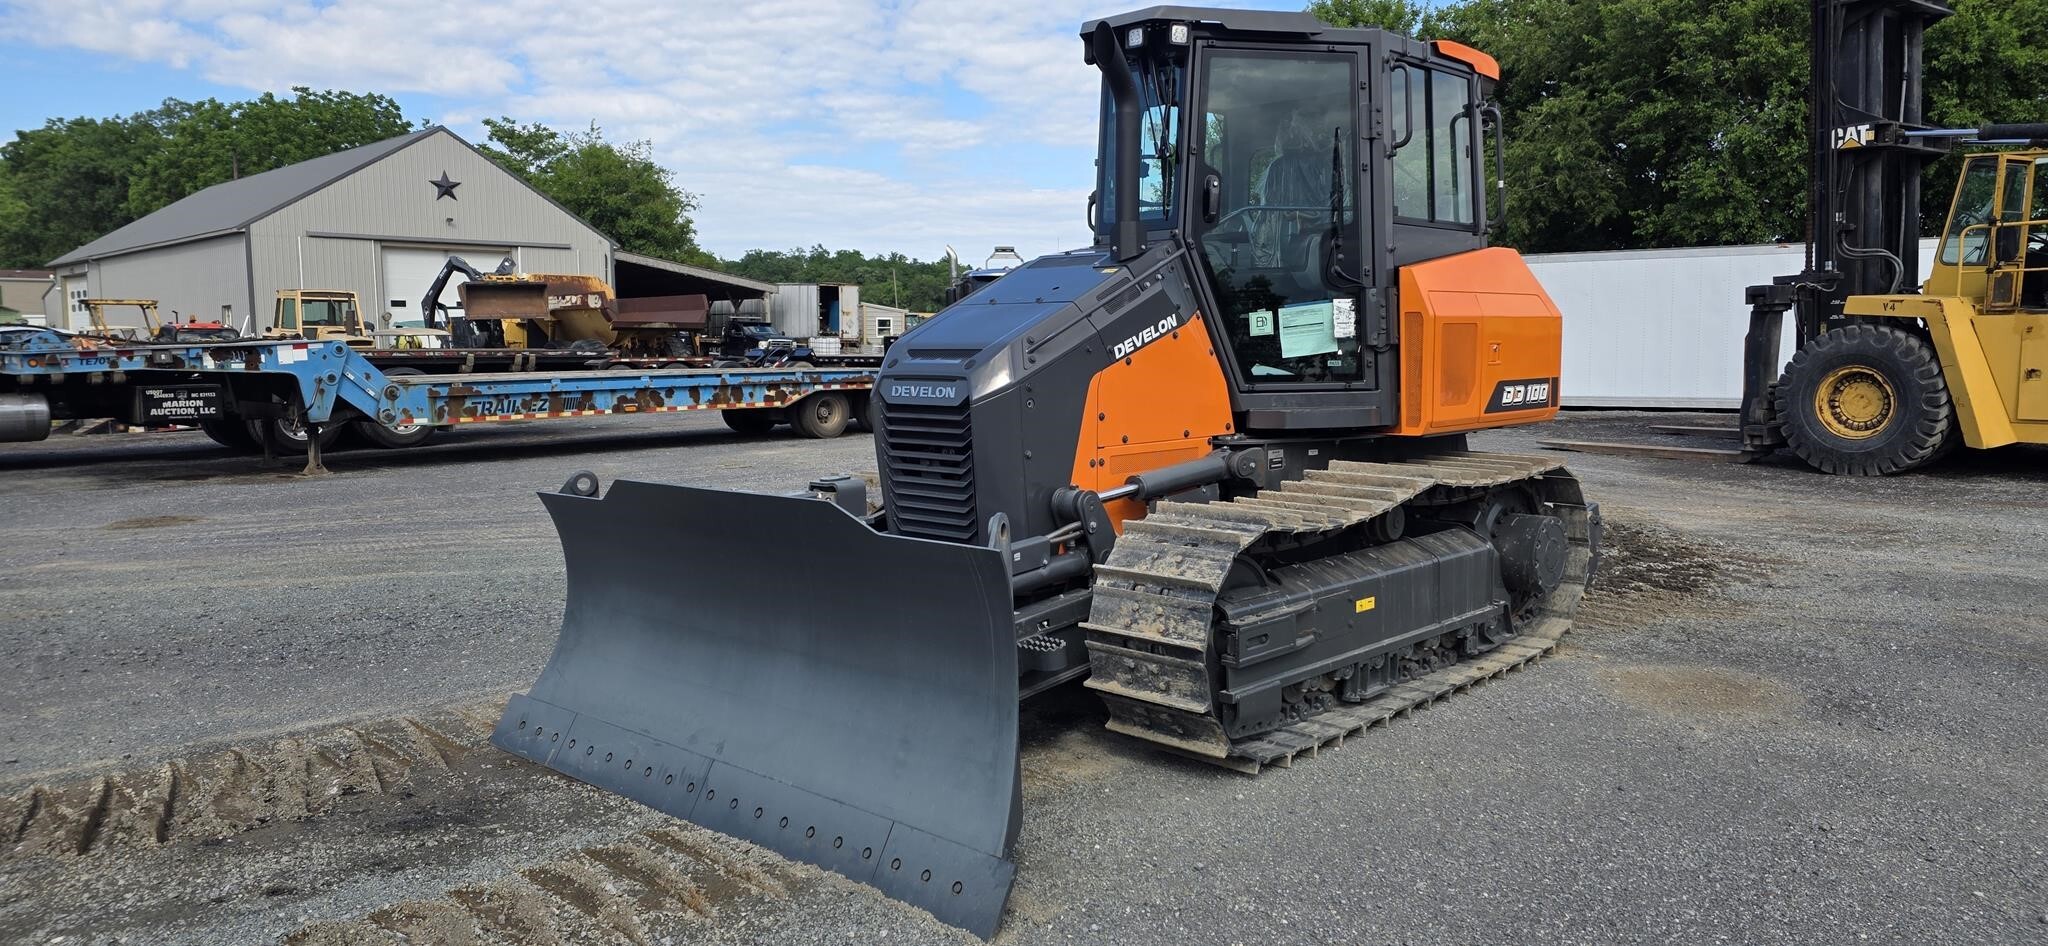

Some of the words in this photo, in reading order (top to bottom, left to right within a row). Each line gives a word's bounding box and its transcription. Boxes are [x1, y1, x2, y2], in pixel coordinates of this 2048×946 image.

[1831, 124, 1870, 149] CAT
[1113, 313, 1178, 360] DEVELON
[891, 385, 956, 398] DEVELON
[1501, 384, 1525, 406] DD
[1526, 383, 1549, 404] 100
[150, 407, 198, 416] AUCTION,
[162, 400, 203, 408] MARION
